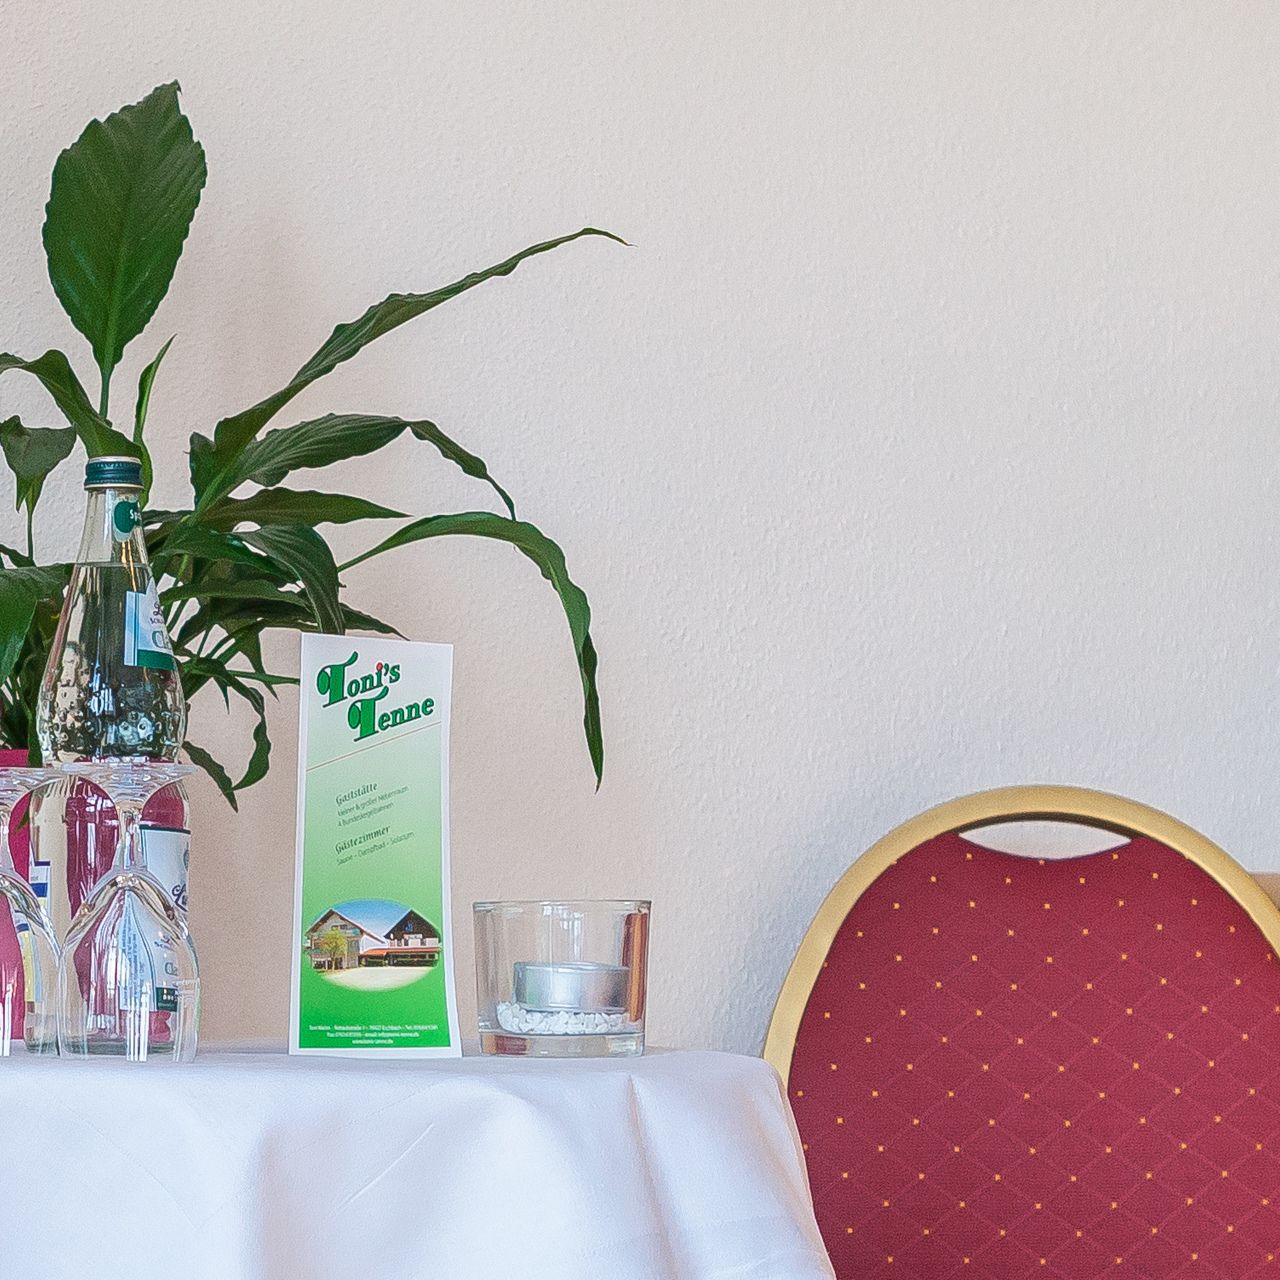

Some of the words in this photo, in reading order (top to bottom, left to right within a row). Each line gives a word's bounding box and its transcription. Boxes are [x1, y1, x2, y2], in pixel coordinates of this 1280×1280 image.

[317, 651, 400, 708] Toni's
[348, 686, 435, 742] Tenne
[336, 783, 377, 806] Gaststätte
[335, 826, 391, 855] Gästezimmer
